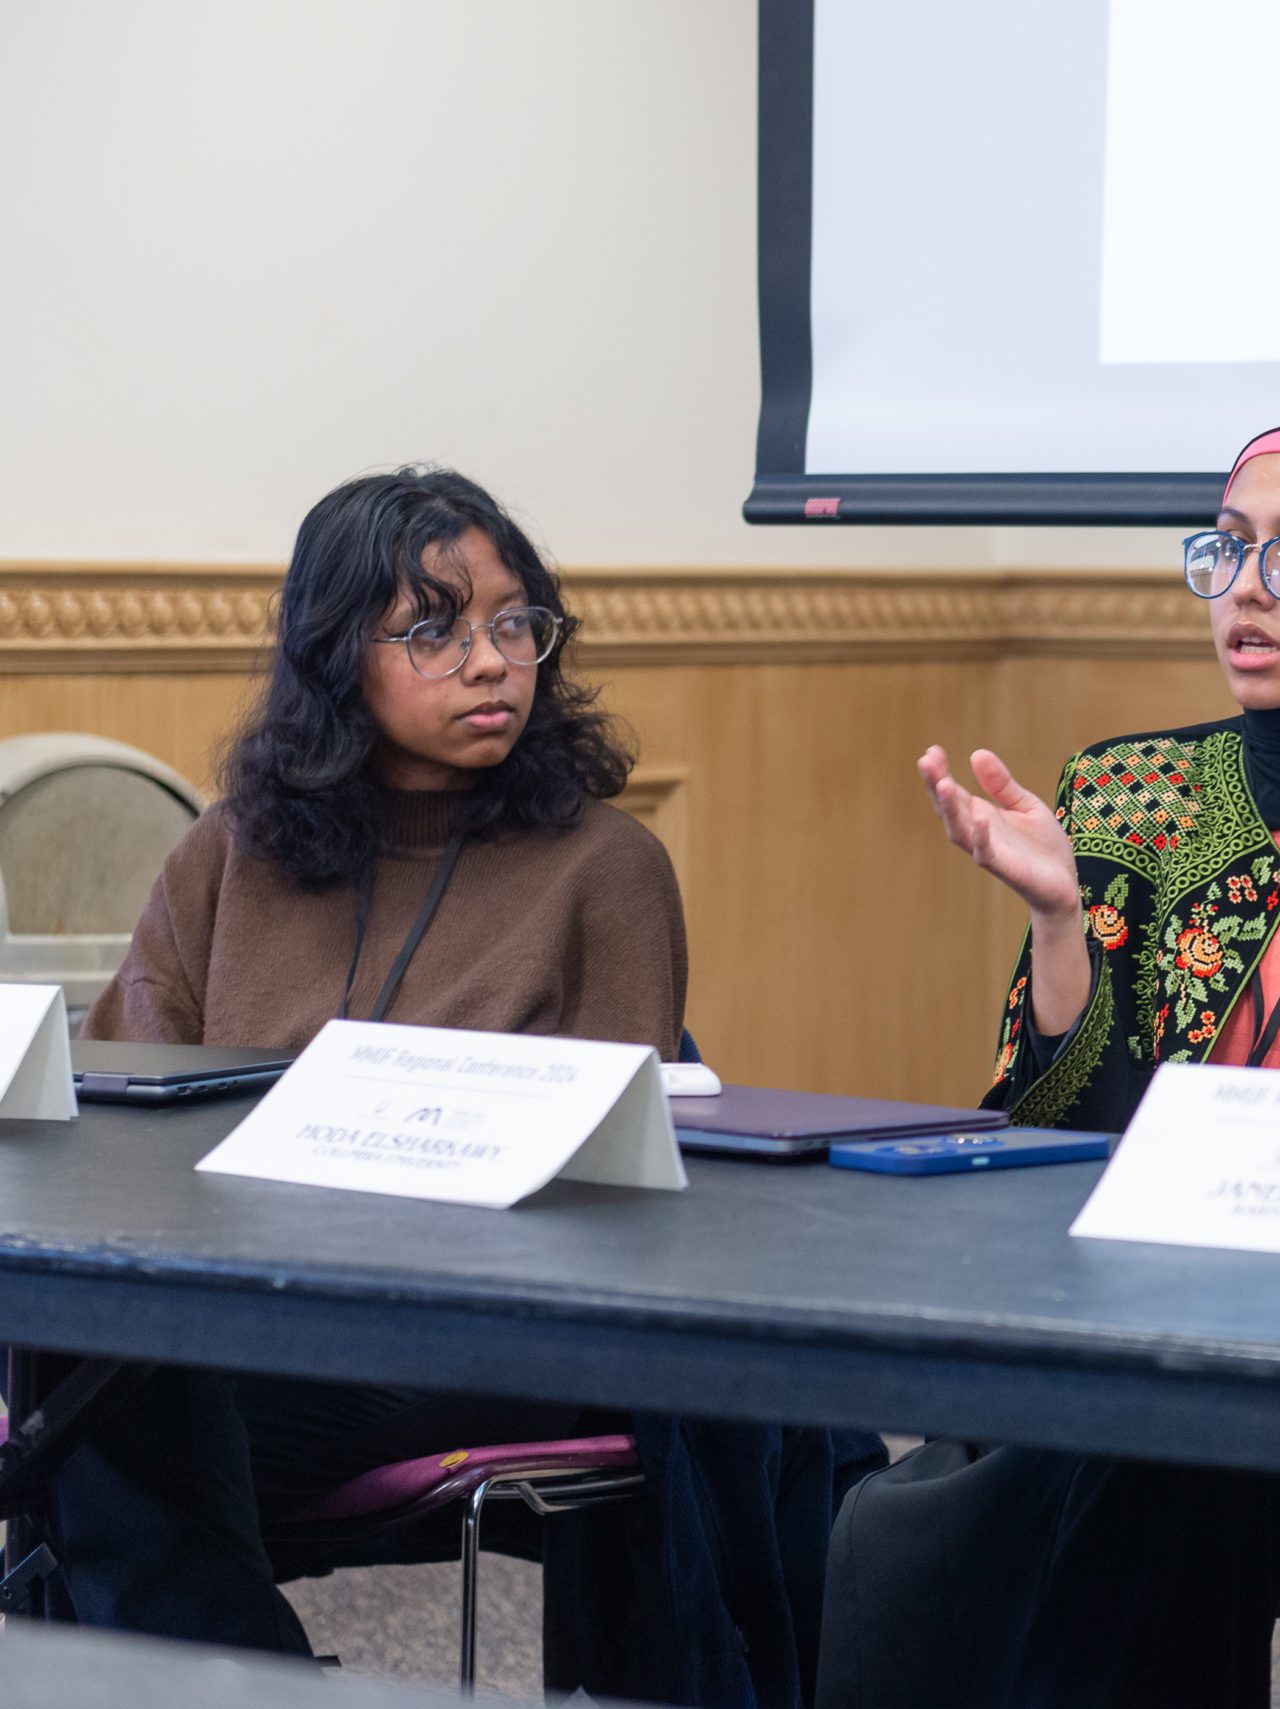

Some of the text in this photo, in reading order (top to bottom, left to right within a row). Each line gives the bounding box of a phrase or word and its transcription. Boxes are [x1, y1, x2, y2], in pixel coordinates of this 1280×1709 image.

[394, 1049, 458, 1073] Regional
[455, 1056, 540, 1080] Conference
[296, 1124, 361, 1145] HODA
